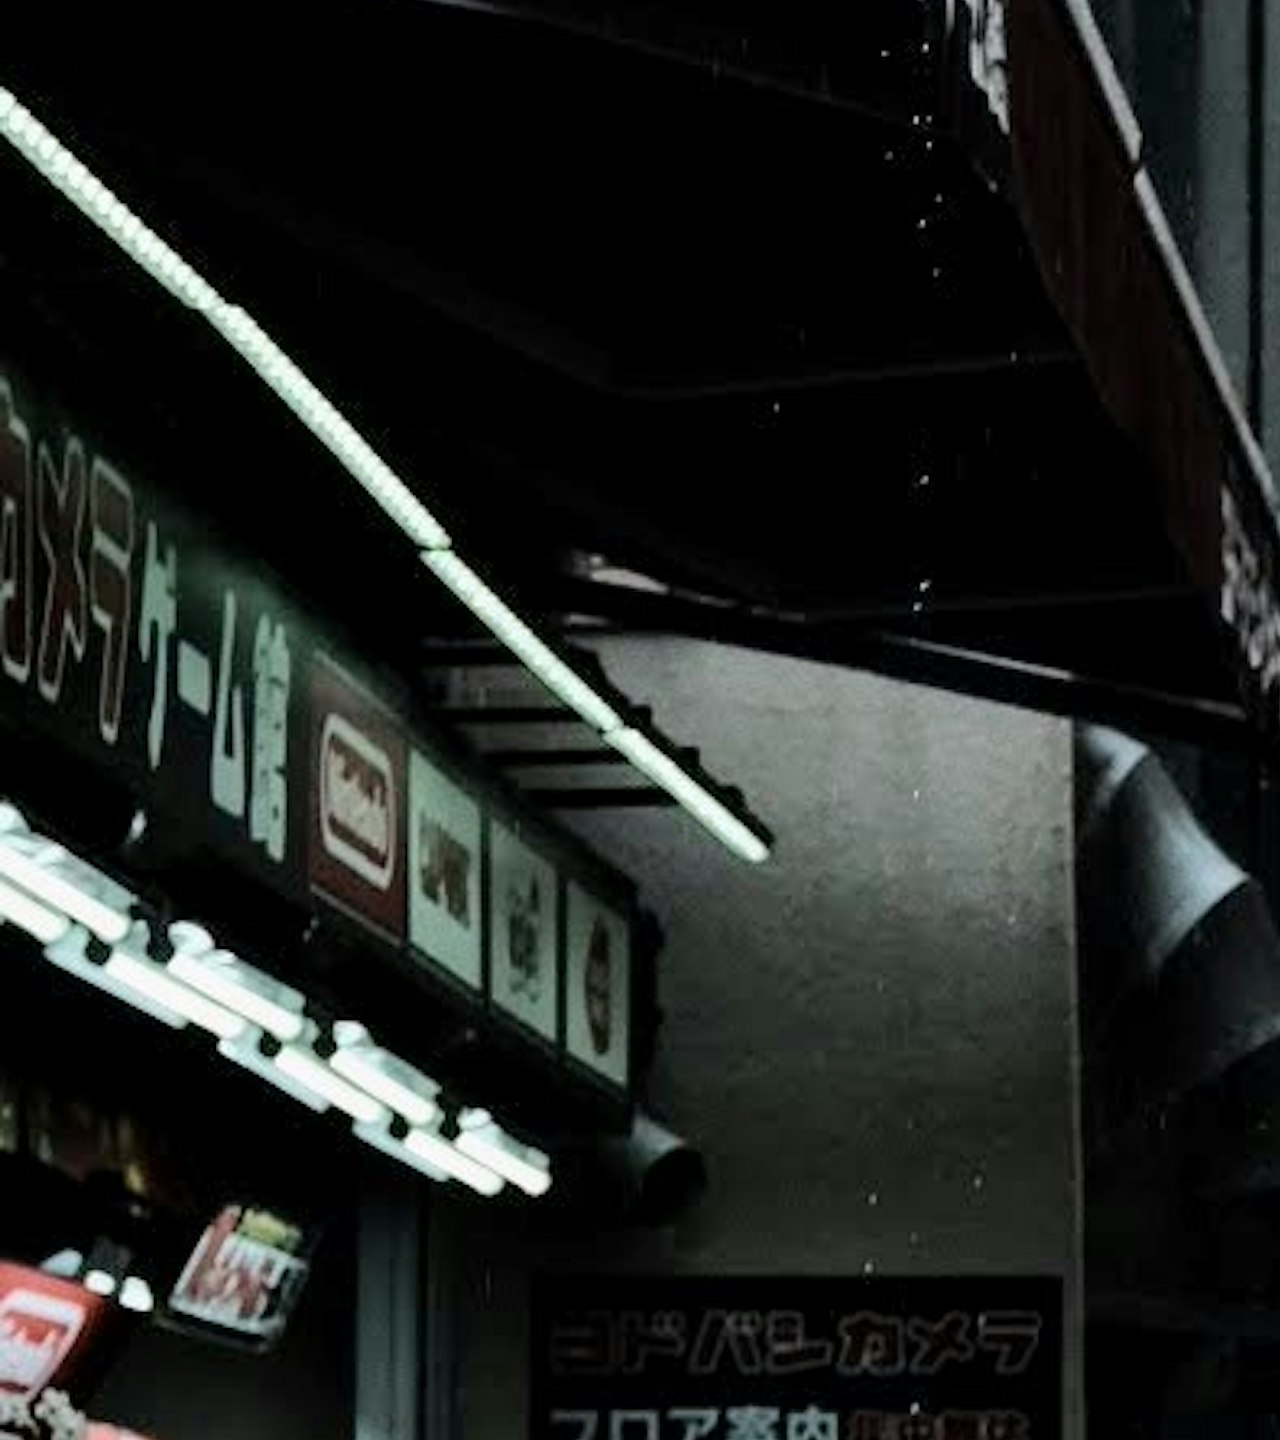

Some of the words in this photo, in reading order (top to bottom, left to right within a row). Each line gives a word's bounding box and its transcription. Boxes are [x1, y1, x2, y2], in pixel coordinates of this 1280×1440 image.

[548, 1308, 1044, 1378] ヨドバシカメラ
